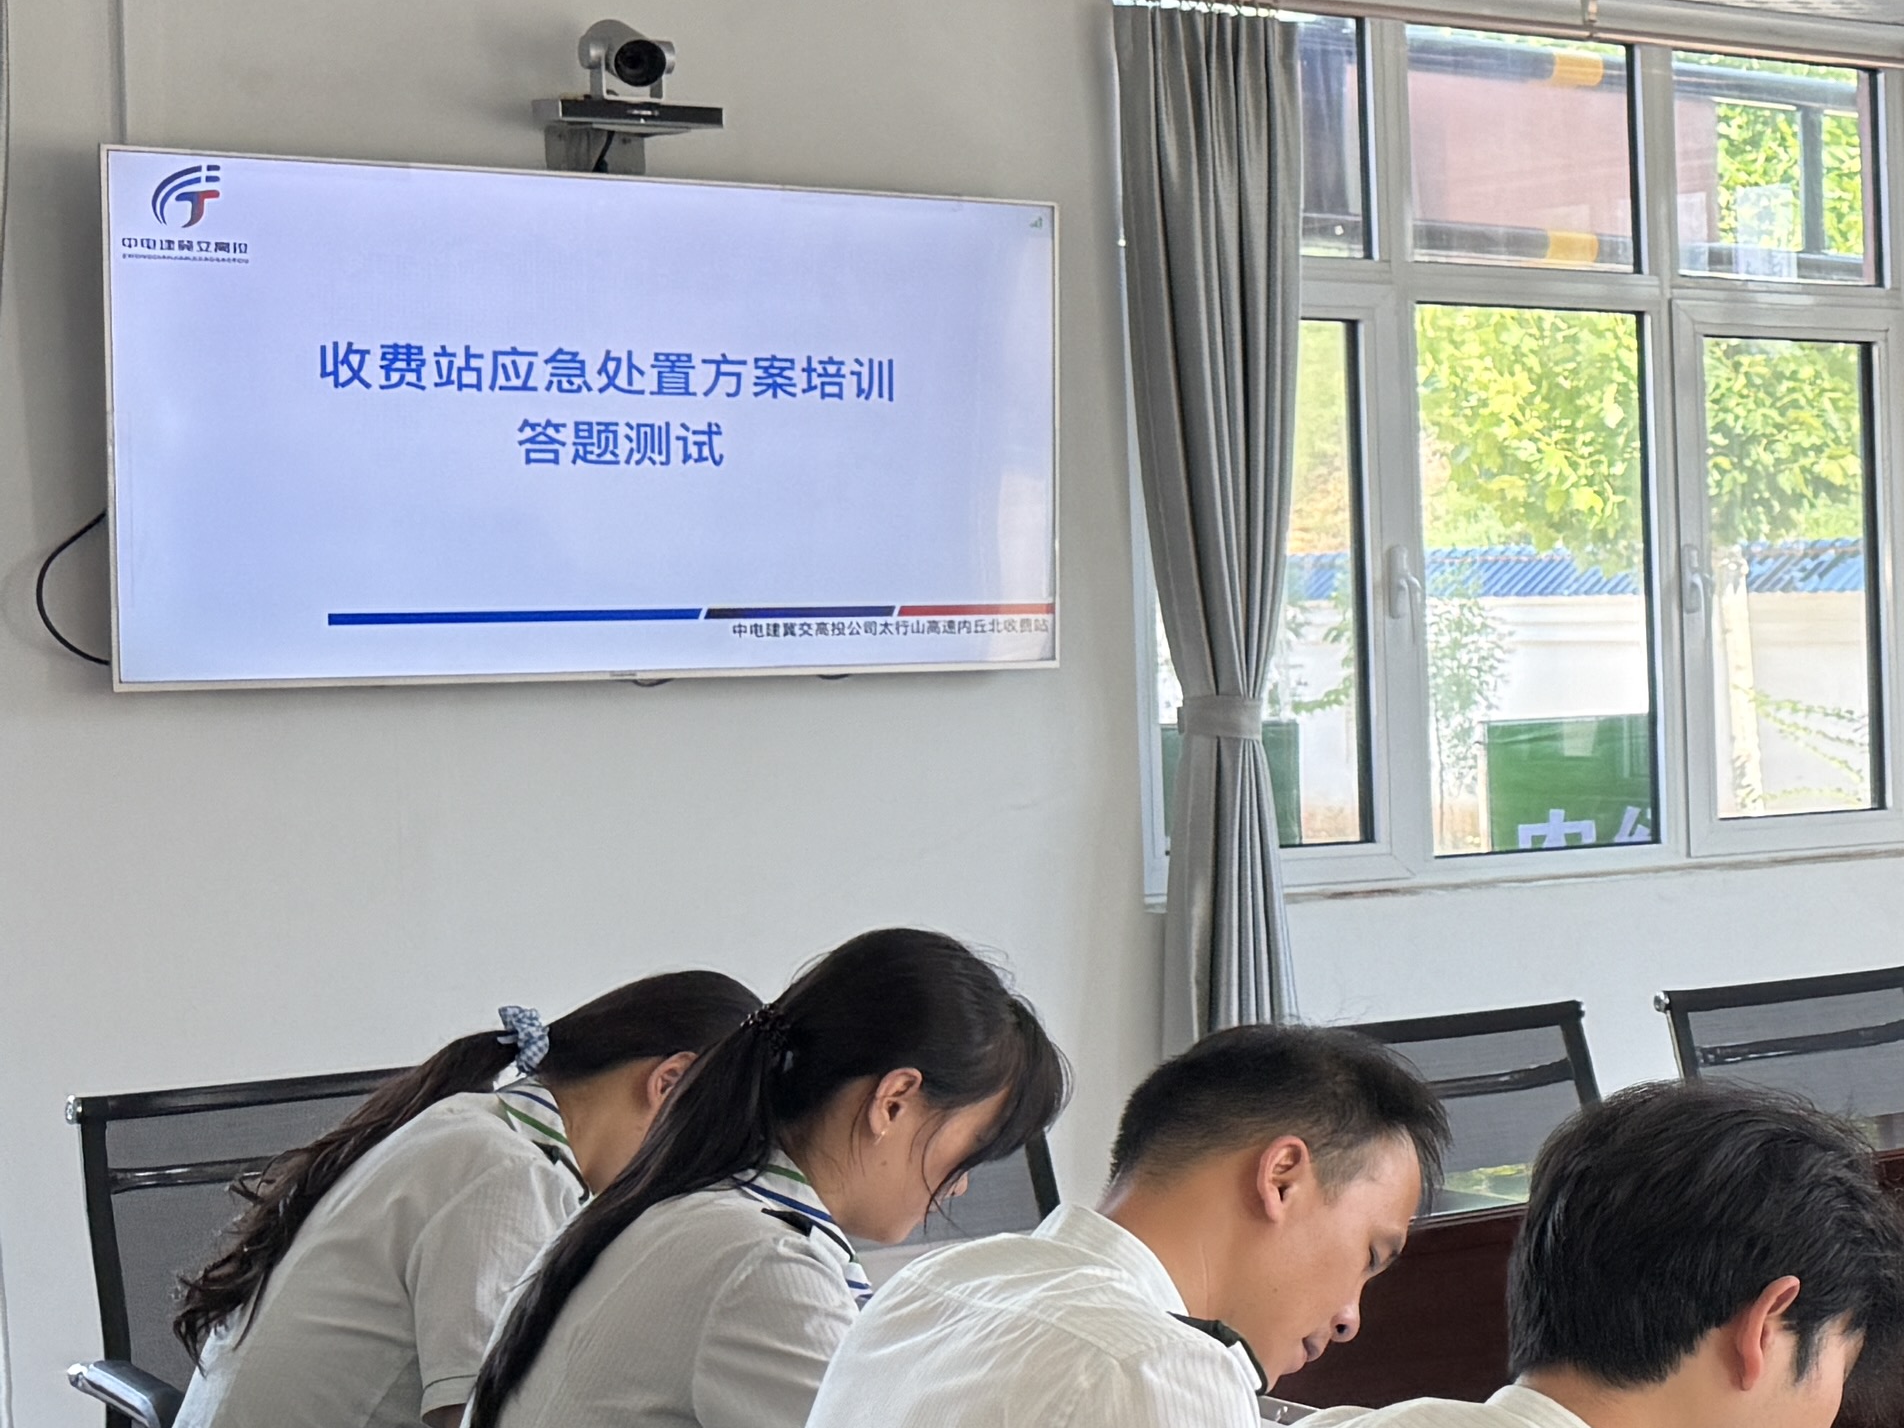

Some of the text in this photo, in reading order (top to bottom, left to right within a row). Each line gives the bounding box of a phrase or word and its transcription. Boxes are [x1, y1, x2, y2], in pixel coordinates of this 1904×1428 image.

[319, 341, 895, 402] 收费站应急处置方案培训
[517, 419, 723, 467] 答题测试
